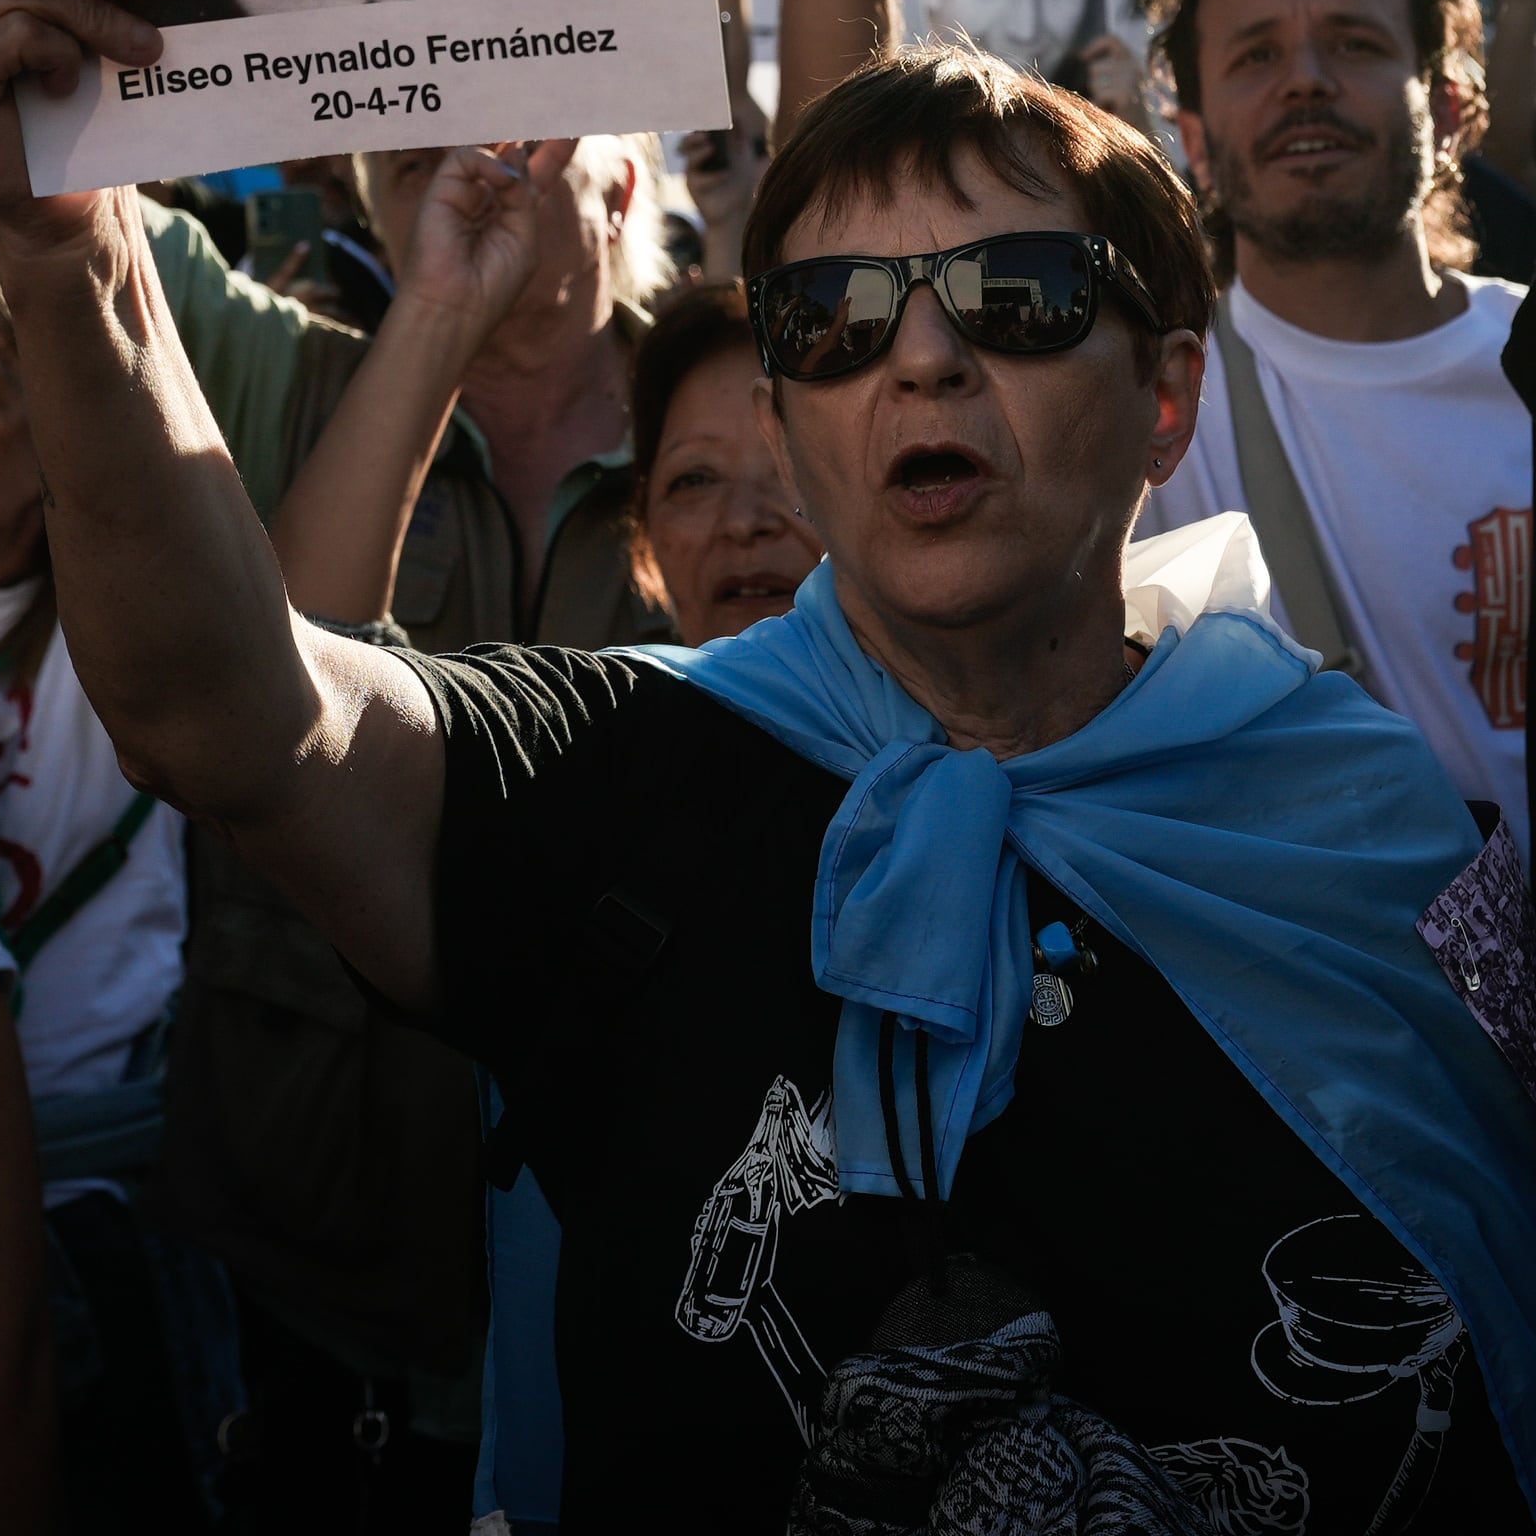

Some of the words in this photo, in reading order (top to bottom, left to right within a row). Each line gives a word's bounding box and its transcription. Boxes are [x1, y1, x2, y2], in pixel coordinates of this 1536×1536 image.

[117, 61, 234, 101] Eliseo
[243, 36, 416, 87] Reynaldo
[426, 25, 618, 65] Fernández
[311, 82, 442, 123] 20-4-76
